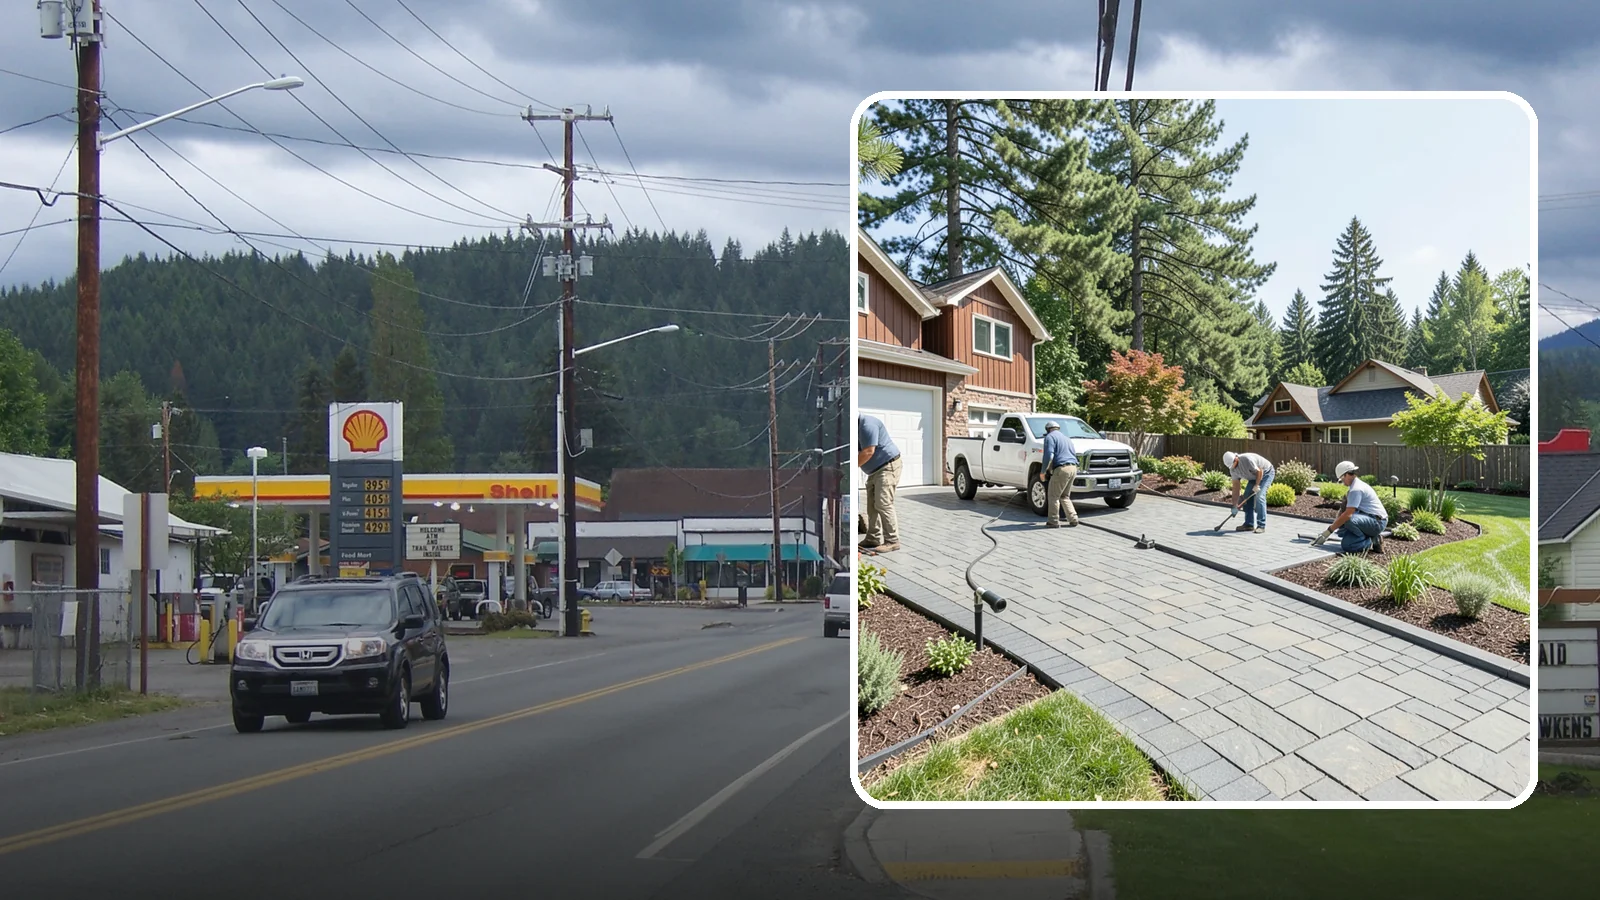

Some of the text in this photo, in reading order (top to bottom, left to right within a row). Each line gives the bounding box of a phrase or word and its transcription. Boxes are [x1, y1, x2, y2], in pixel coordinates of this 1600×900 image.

[366, 480, 384, 490] 395
[490, 484, 547, 499] Shell
[366, 494, 384, 504] 405
[366, 508, 384, 518] 415
[366, 522, 384, 532] 429
[1538, 643, 1566, 665] AID
